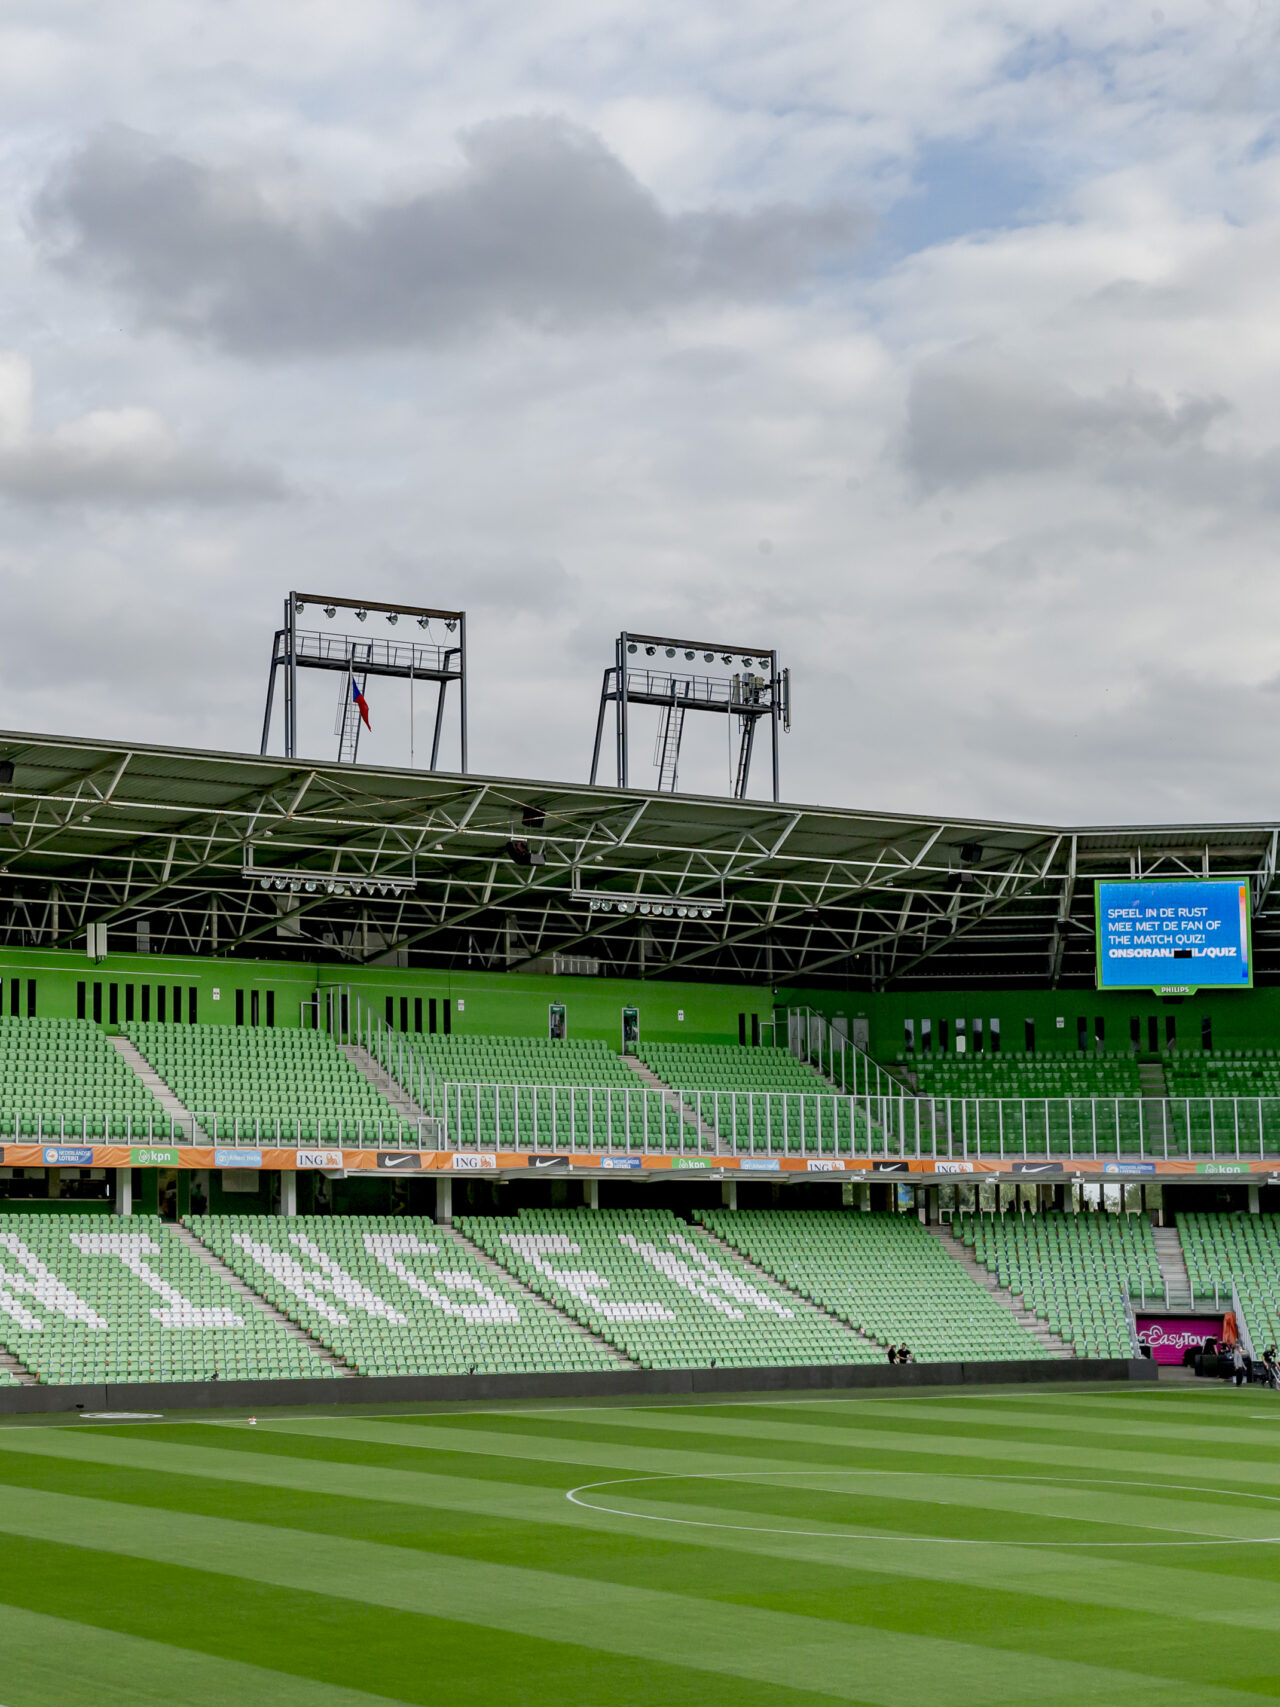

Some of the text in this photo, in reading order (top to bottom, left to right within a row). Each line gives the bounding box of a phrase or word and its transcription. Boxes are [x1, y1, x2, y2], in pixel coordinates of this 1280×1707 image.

[1108, 907, 1208, 918] SPEEL IN DE RUST
[1108, 920, 1222, 932] MEE MET DE FAN OF
[1109, 934, 1205, 945] THE MATCH QUIZ!
[1109, 947, 1237, 958] ONSORANJL/QUIZ
[151, 1151, 171, 1163] kpn
[300, 1155, 323, 1165] ING
[456, 1158, 478, 1168] ING
[1148, 1331, 1213, 1349] EasyToy
